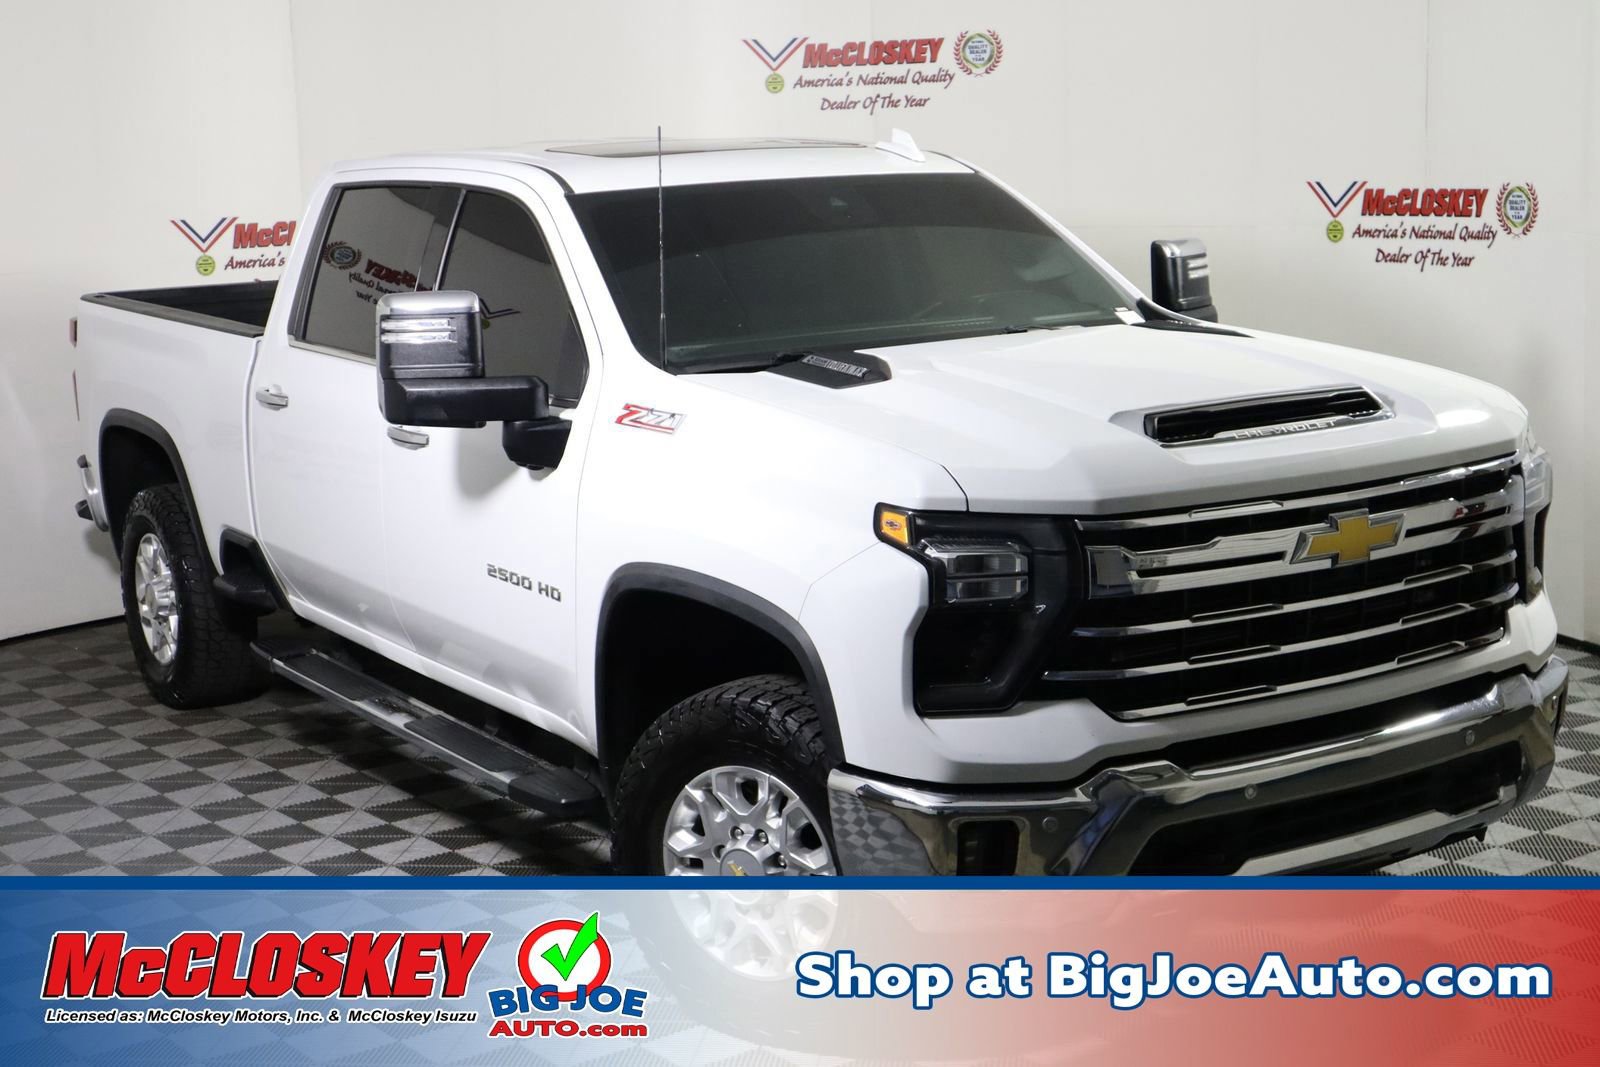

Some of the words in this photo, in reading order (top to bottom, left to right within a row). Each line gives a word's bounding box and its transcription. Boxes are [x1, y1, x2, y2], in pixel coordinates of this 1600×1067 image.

[802, 37, 945, 69] McCLOSKEY
[793, 71, 853, 89] America's
[857, 69, 908, 85] National
[912, 67, 956, 90] Quality
[820, 96, 861, 111] Dealer
[862, 93, 881, 115] Of
[880, 95, 901, 109] The
[903, 95, 931, 108] Year
[1361, 188, 1489, 218] McCLOSKEY
[1352, 221, 1407, 239] America's
[1409, 222, 1456, 241] National
[1459, 223, 1498, 249] Quality
[224, 251, 286, 270] America's
[1375, 247, 1412, 264] Dealer
[1414, 250, 1431, 272] Of
[1430, 250, 1450, 267] The
[1452, 251, 1475, 268] Year
[1233, 418, 1338, 440] CHEVROLET
[487, 563, 532, 591] 2500
[538, 581, 561, 602] HD
